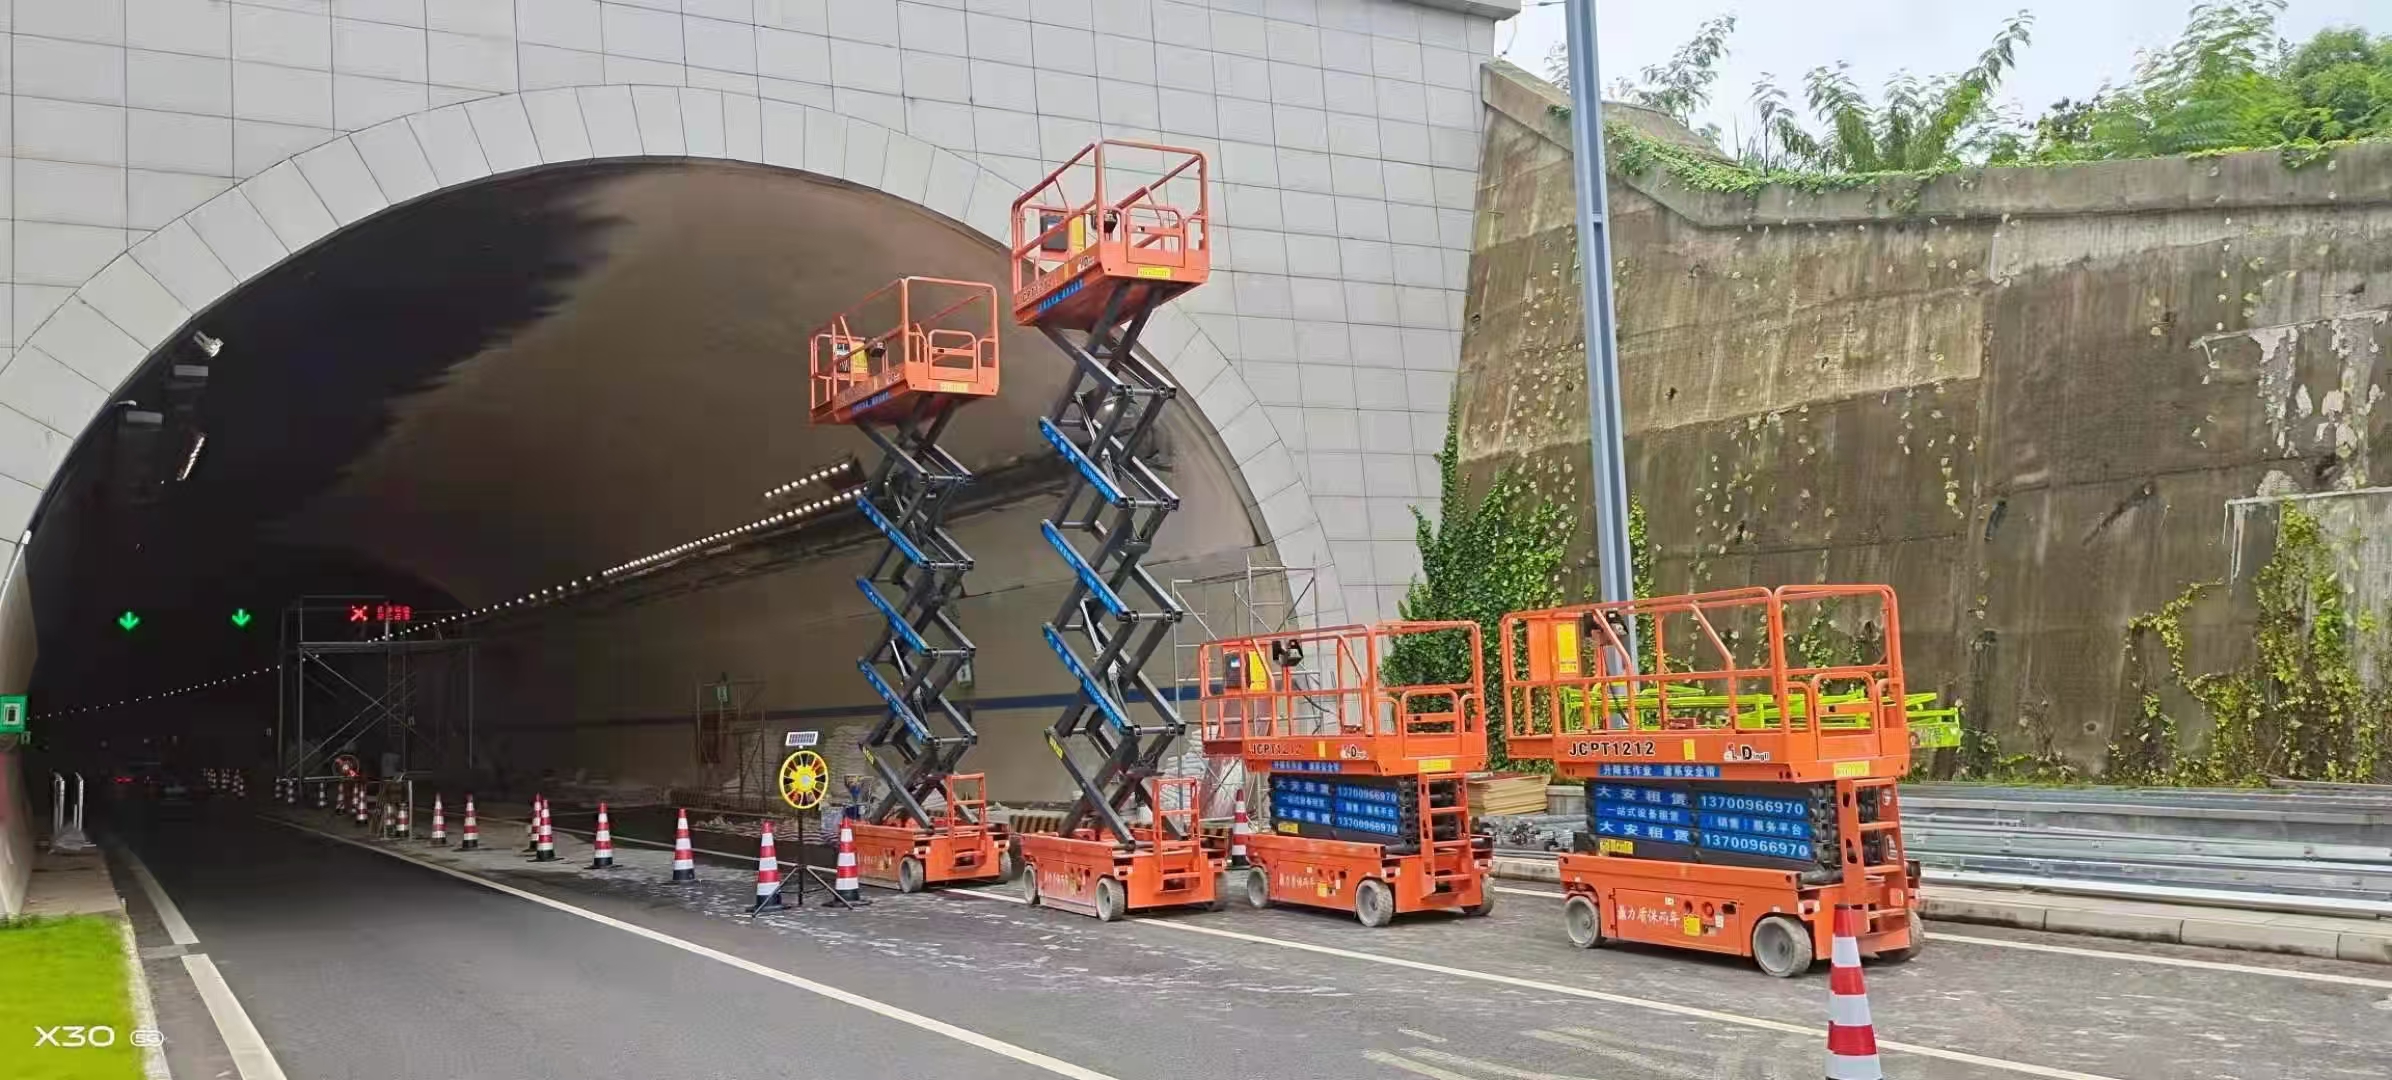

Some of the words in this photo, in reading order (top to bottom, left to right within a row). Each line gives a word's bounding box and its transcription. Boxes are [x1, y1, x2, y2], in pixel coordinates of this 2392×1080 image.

[1569, 741, 1655, 756] JCPT1212
[1701, 796, 1804, 815] 13700966970
[1599, 820, 1689, 842] 大安租赁
[1703, 834, 1808, 857] 13700966970
